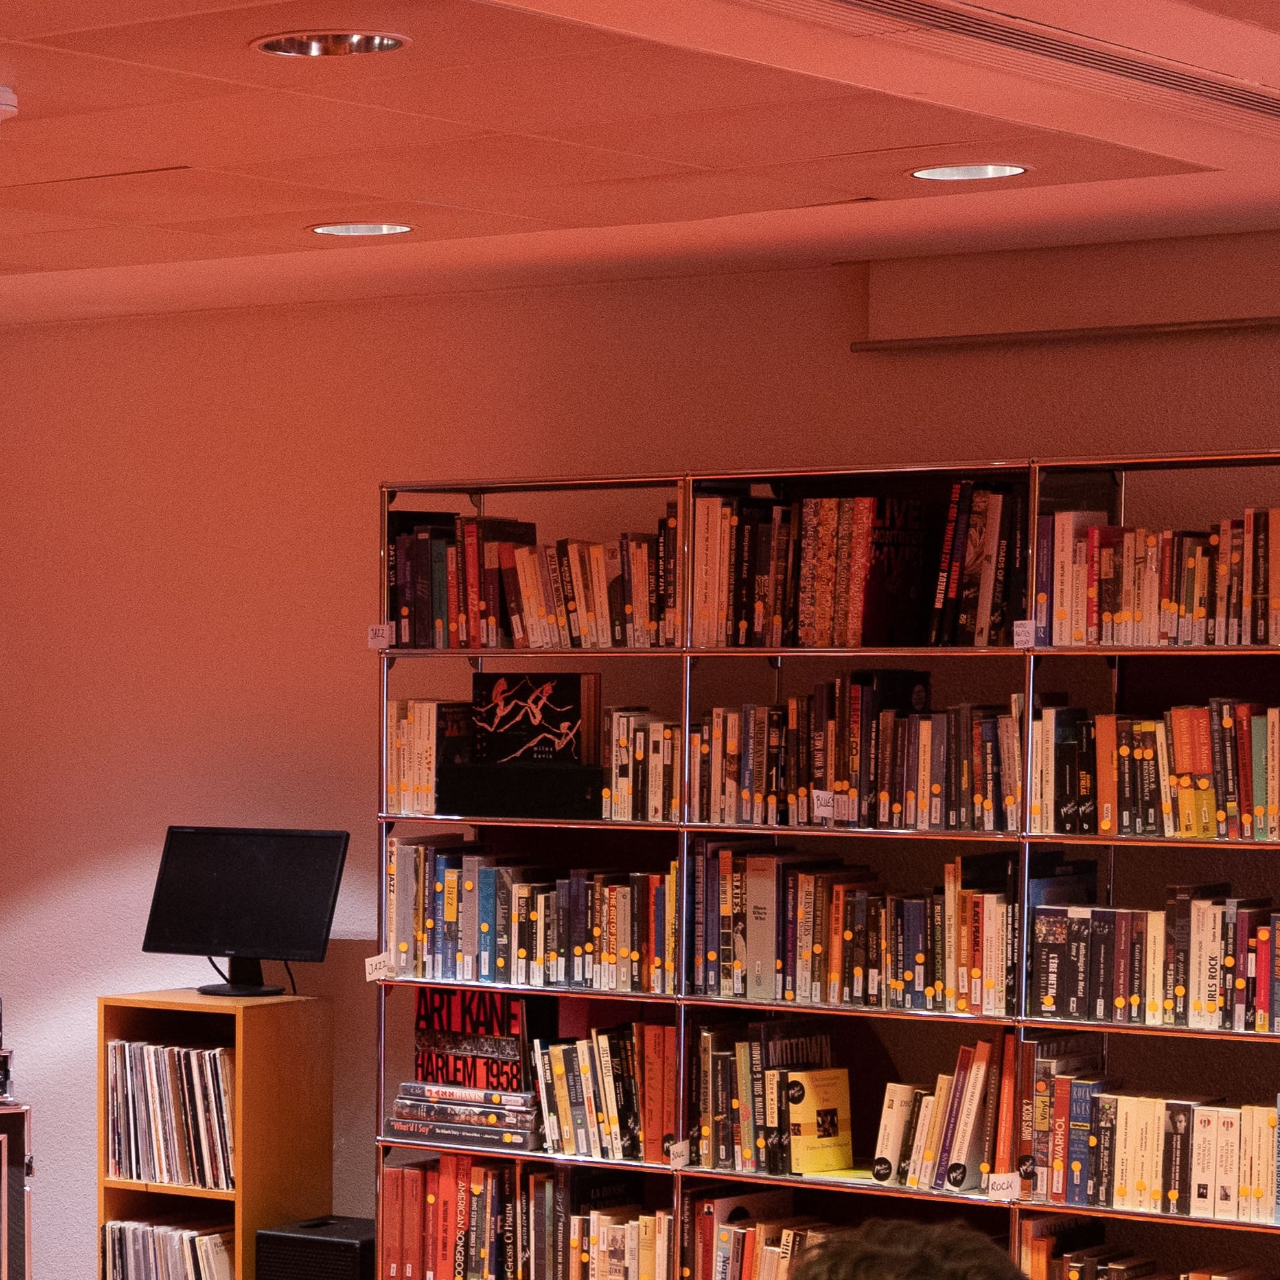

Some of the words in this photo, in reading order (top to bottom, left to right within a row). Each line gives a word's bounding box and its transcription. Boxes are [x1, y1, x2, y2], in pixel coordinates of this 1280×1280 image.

[742, 525, 751, 561] European
[942, 522, 955, 553] FESTIVAL
[940, 554, 950, 571] JAZZ
[997, 540, 1007, 570] ROADS
[947, 561, 960, 599] MONTREUX
[997, 571, 1005, 582] OF
[934, 572, 948, 608] MONTREUX
[1180, 718, 1188, 743] World
[814, 750, 823, 767] WANT
[1182, 744, 1190, 769] Music
[814, 768, 823, 778] WE
[447, 886, 455, 907] Jazz
[733, 873, 741, 913] BLUES
[972, 900, 980, 925] BLACK
[609, 923, 616, 934] OF
[972, 926, 980, 953] PEARLS
[368, 961, 387, 975] JAZZ
[1207, 955, 1218, 981] ROCK
[1077, 981, 1085, 997] Metal
[1166, 971, 1174, 999] RACINES
[1207, 983, 1217, 1002] IRLS
[417, 987, 457, 1032] ART
[461, 990, 520, 1037] KANE
[752, 1042, 761, 1072] GLAMOUR
[769, 1035, 831, 1068] MOTOWN
[415, 1052, 476, 1088] HARLEM
[484, 1058, 520, 1091] 1958
[603, 1059, 612, 1078] PEOPLE
[754, 1079, 762, 1096] SOUL
[1073, 1087, 1091, 1099] ROCK
[754, 1097, 764, 1126] MOTOWN
[1022, 1105, 1032, 1123] ROCK
[1073, 1103, 1090, 1115] AGES
[956, 1126, 969, 1162] ANTHOLOGIE
[1022, 1123, 1032, 1141] WHO'S
[1054, 1117, 1065, 1161] WARHOL
[1103, 1130, 1111, 1148] THE
[941, 1153, 949, 1166] ANS
[991, 1180, 1014, 1192] ROCK
[457, 1181, 465, 1228] AMERICAN
[504, 1203, 513, 1231] HARLEM
[504, 1232, 513, 1243] OF
[781, 1233, 791, 1260] Miles
[455, 1230, 465, 1277] SONGBOO
[504, 1245, 513, 1272] GHOSTS
